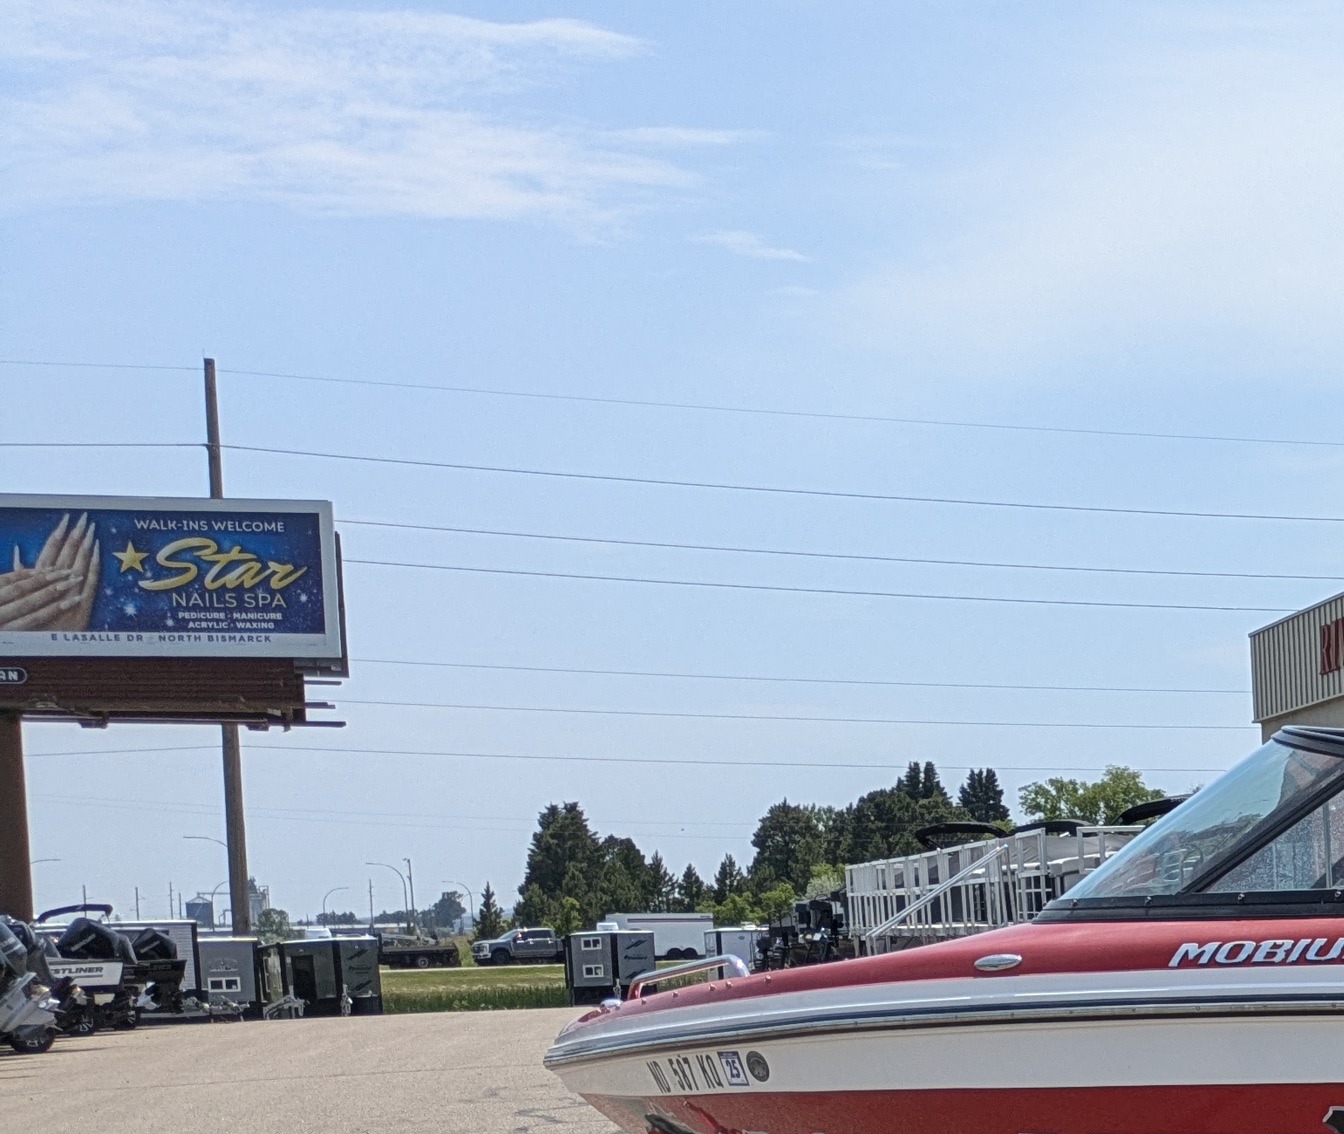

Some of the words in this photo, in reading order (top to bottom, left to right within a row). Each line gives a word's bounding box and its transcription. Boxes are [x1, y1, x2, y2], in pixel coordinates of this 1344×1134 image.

[134, 518, 208, 531] WALK-INS
[211, 520, 285, 533] WELCOME
[137, 536, 308, 591] Star
[172, 592, 237, 608] NAILS
[244, 593, 287, 608] SPA
[178, 612, 226, 620] PEDICURE
[232, 612, 283, 620] MANICURE
[187, 621, 229, 629] ACRYLIC
[235, 621, 275, 629] WAXING
[63, 634, 121, 642] LASALLE
[126, 634, 144, 642] DR
[158, 634, 202, 643] NORTH
[207, 634, 272, 643] BISMARCK
[50, 966, 104, 975] STLINER
[725, 1059, 741, 1079] 25
